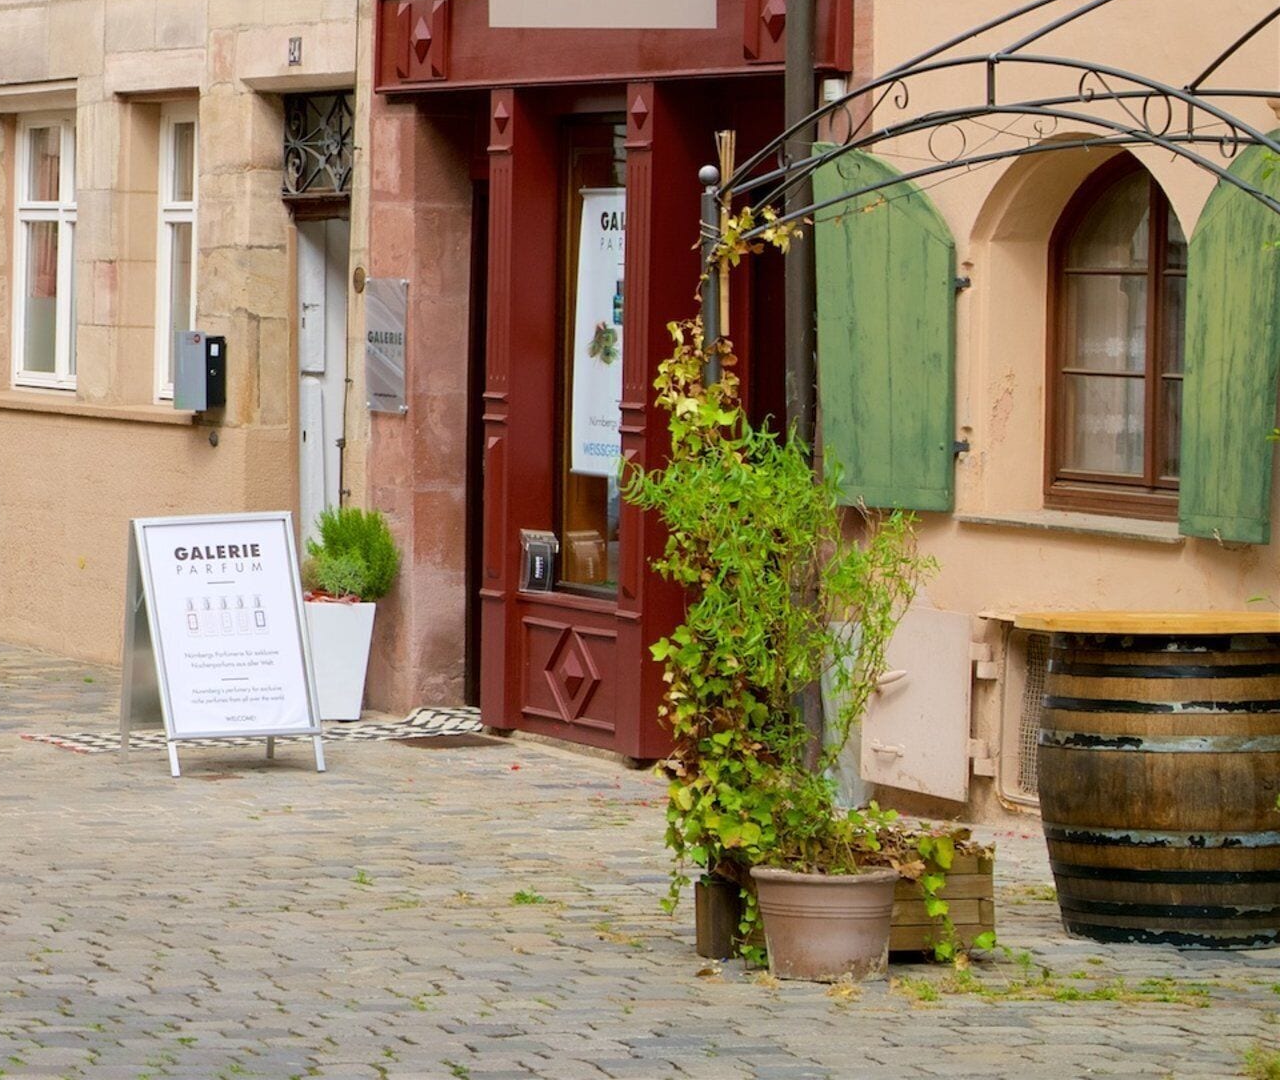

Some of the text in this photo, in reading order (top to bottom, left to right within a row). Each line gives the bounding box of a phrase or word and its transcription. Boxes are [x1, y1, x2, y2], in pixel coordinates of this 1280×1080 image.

[368, 331, 403, 345] GALERIE
[174, 543, 261, 561] GALERIE
[176, 562, 263, 575] PARFUM
